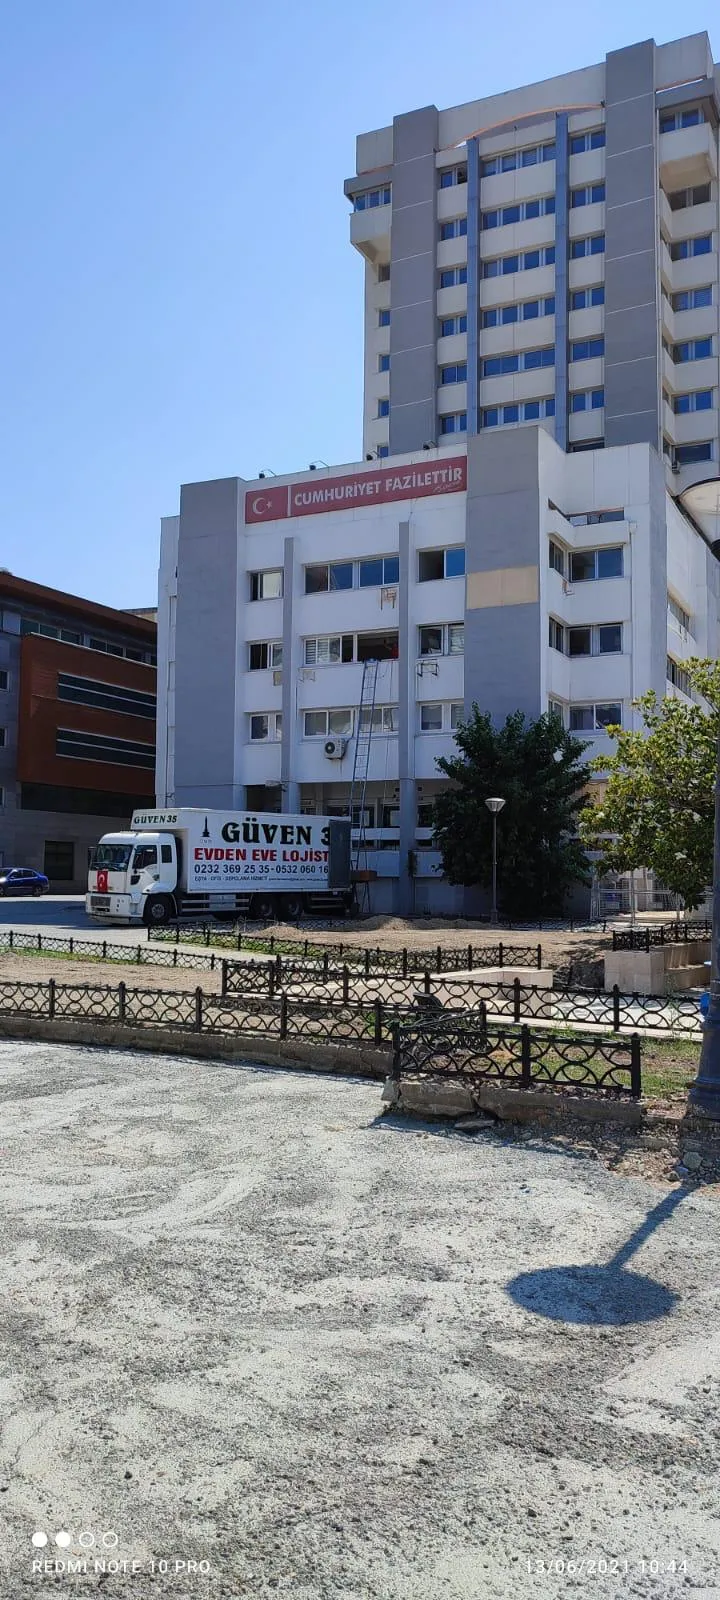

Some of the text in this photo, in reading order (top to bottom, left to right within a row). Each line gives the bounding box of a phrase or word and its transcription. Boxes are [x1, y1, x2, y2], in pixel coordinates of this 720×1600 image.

[294, 481, 382, 506] CUMHURİYET
[385, 465, 462, 492] FAZİLETTİR
[134, 815, 178, 824] GÜVEN 35
[221, 817, 312, 846] GÜVEN
[194, 847, 247, 861] EVDEN
[252, 849, 277, 862] EVE
[194, 864, 220, 874] 0232
[222, 864, 241, 874] 369
[243, 864, 256, 874] 25
[300, 864, 316, 874] 060
